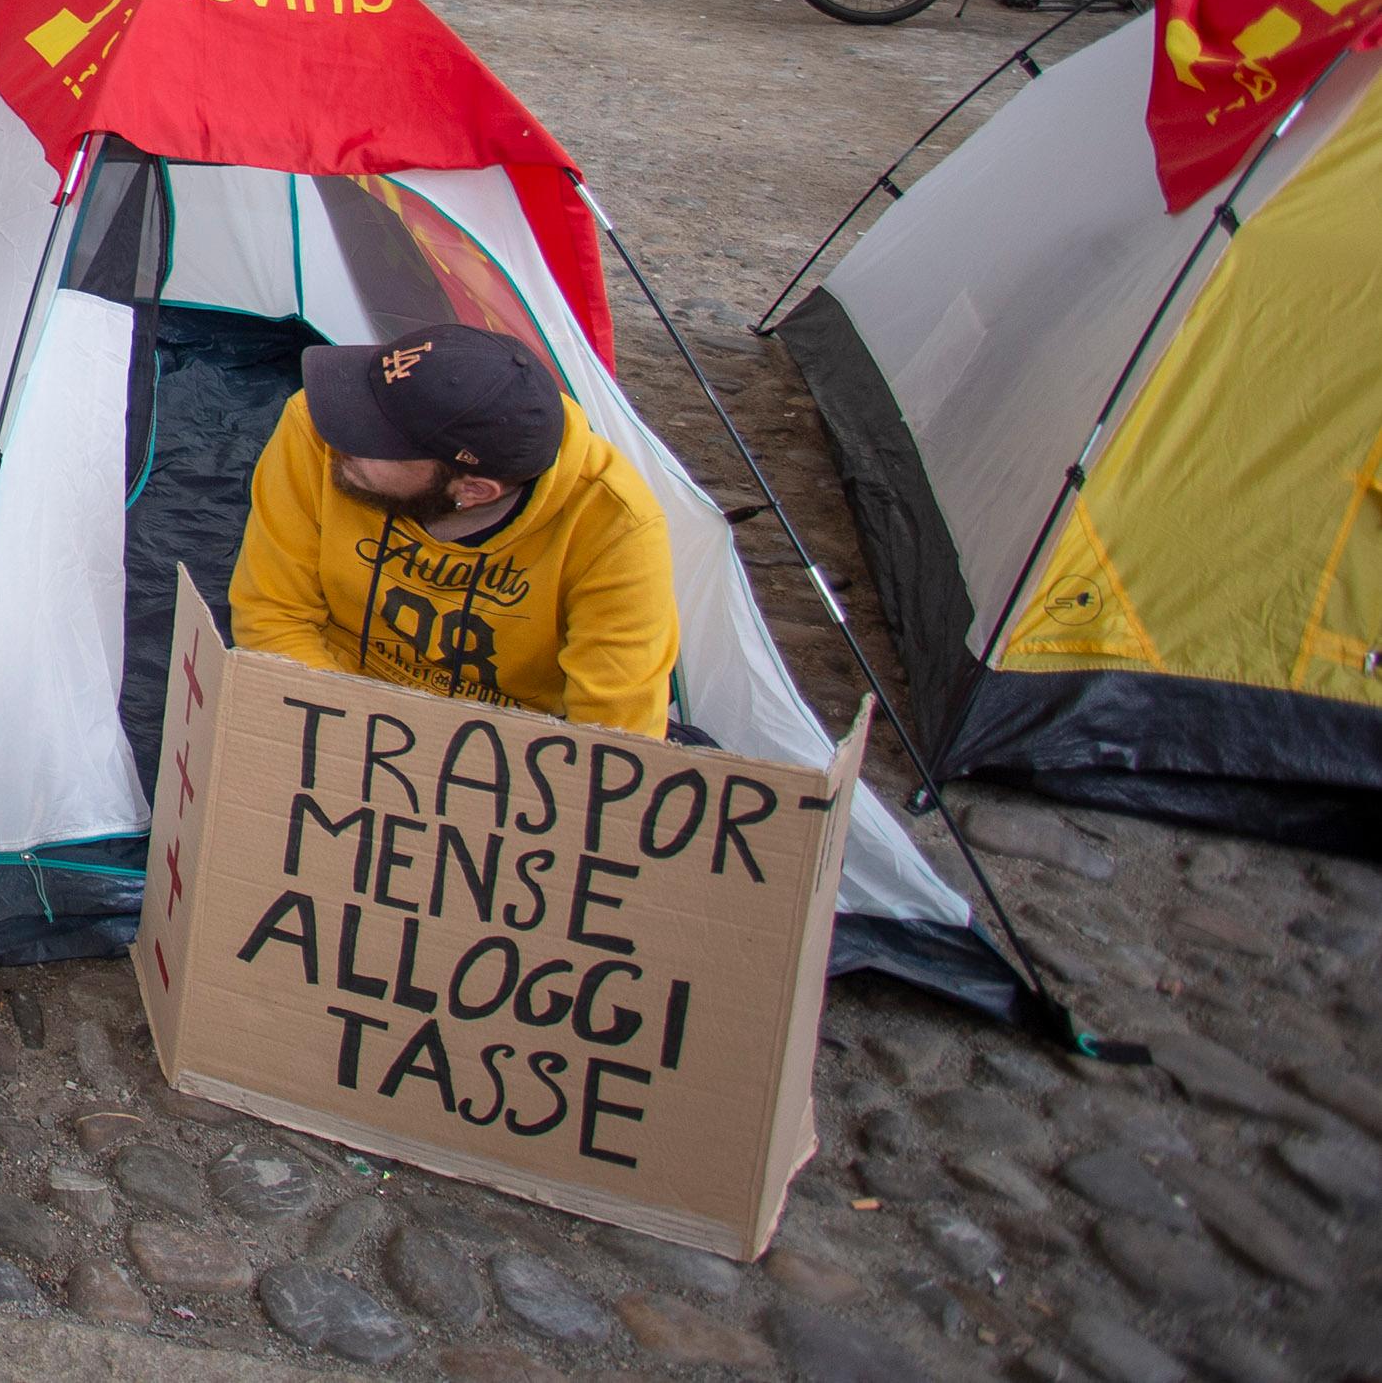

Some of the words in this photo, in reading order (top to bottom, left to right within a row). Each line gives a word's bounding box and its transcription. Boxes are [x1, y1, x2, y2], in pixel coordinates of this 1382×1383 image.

[283, 792, 641, 956] MENSE
[235, 888, 691, 1070] ALLOGGI
[326, 1005, 653, 1170] TASSE
